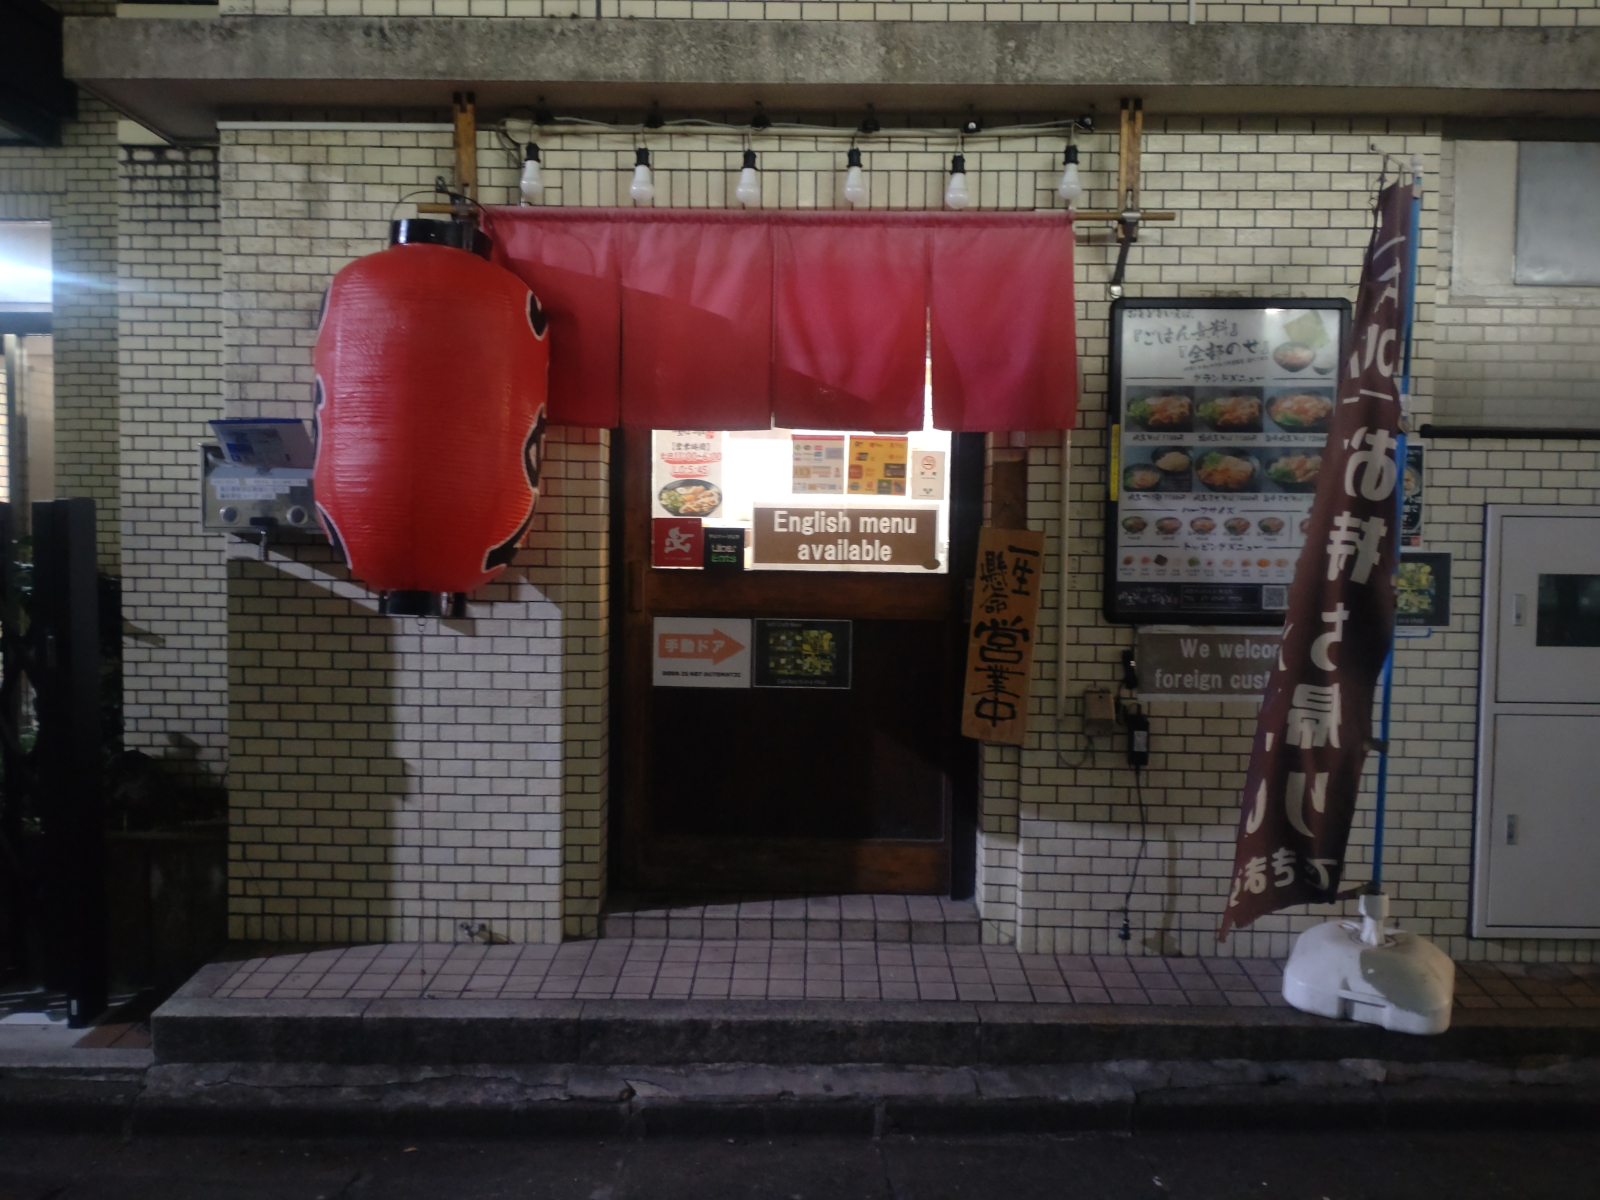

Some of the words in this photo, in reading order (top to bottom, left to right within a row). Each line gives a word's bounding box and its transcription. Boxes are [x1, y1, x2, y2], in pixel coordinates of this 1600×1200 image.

[1193, 373, 1266, 383] グランドメニュー
[774, 510, 850, 535] English
[859, 517, 917, 534] menu
[711, 554, 737, 563] Eats
[797, 539, 893, 562] available
[664, 638, 726, 654] 手動ドア
[1179, 638, 1210, 659] We
[971, 615, 1031, 728] 営業中
[1154, 669, 1222, 691] foreign
